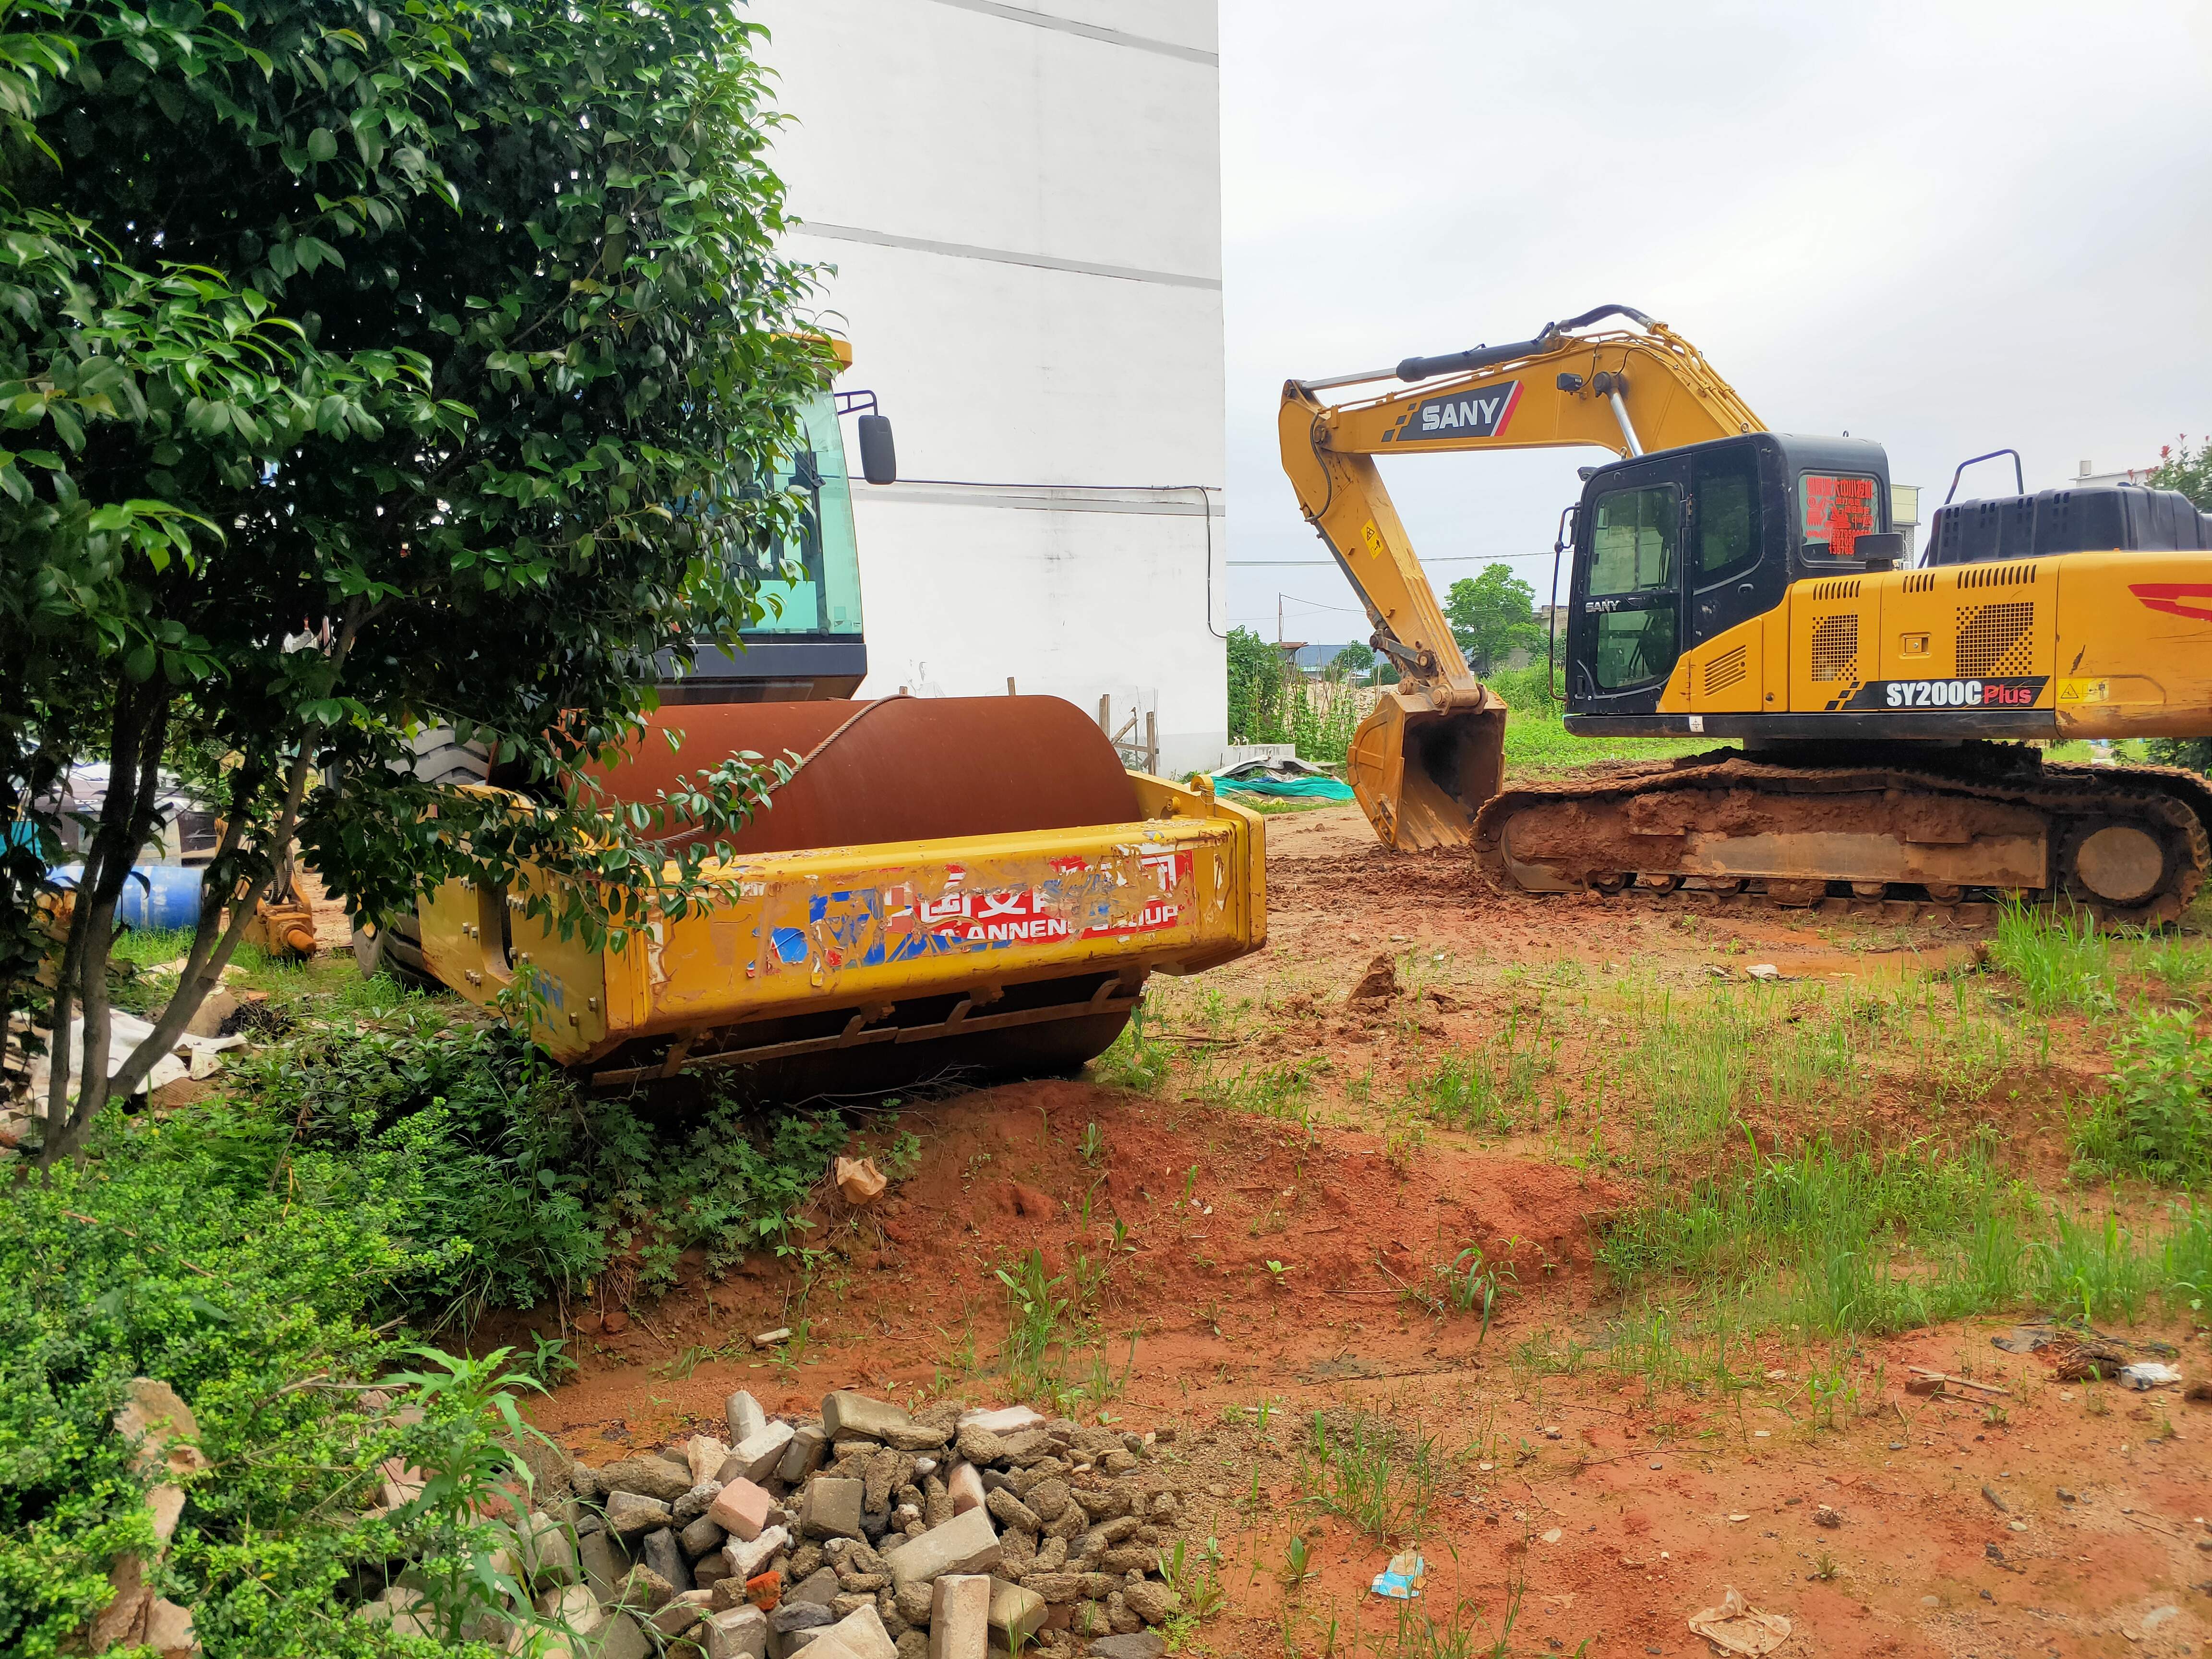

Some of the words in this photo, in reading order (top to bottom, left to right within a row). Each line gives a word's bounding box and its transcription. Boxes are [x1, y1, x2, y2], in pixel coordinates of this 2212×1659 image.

[1422, 397, 1500, 431] SANY
[1586, 600, 1621, 613] SANY
[1886, 681, 1982, 706] SY200C
[1984, 684, 2032, 704] Plus
